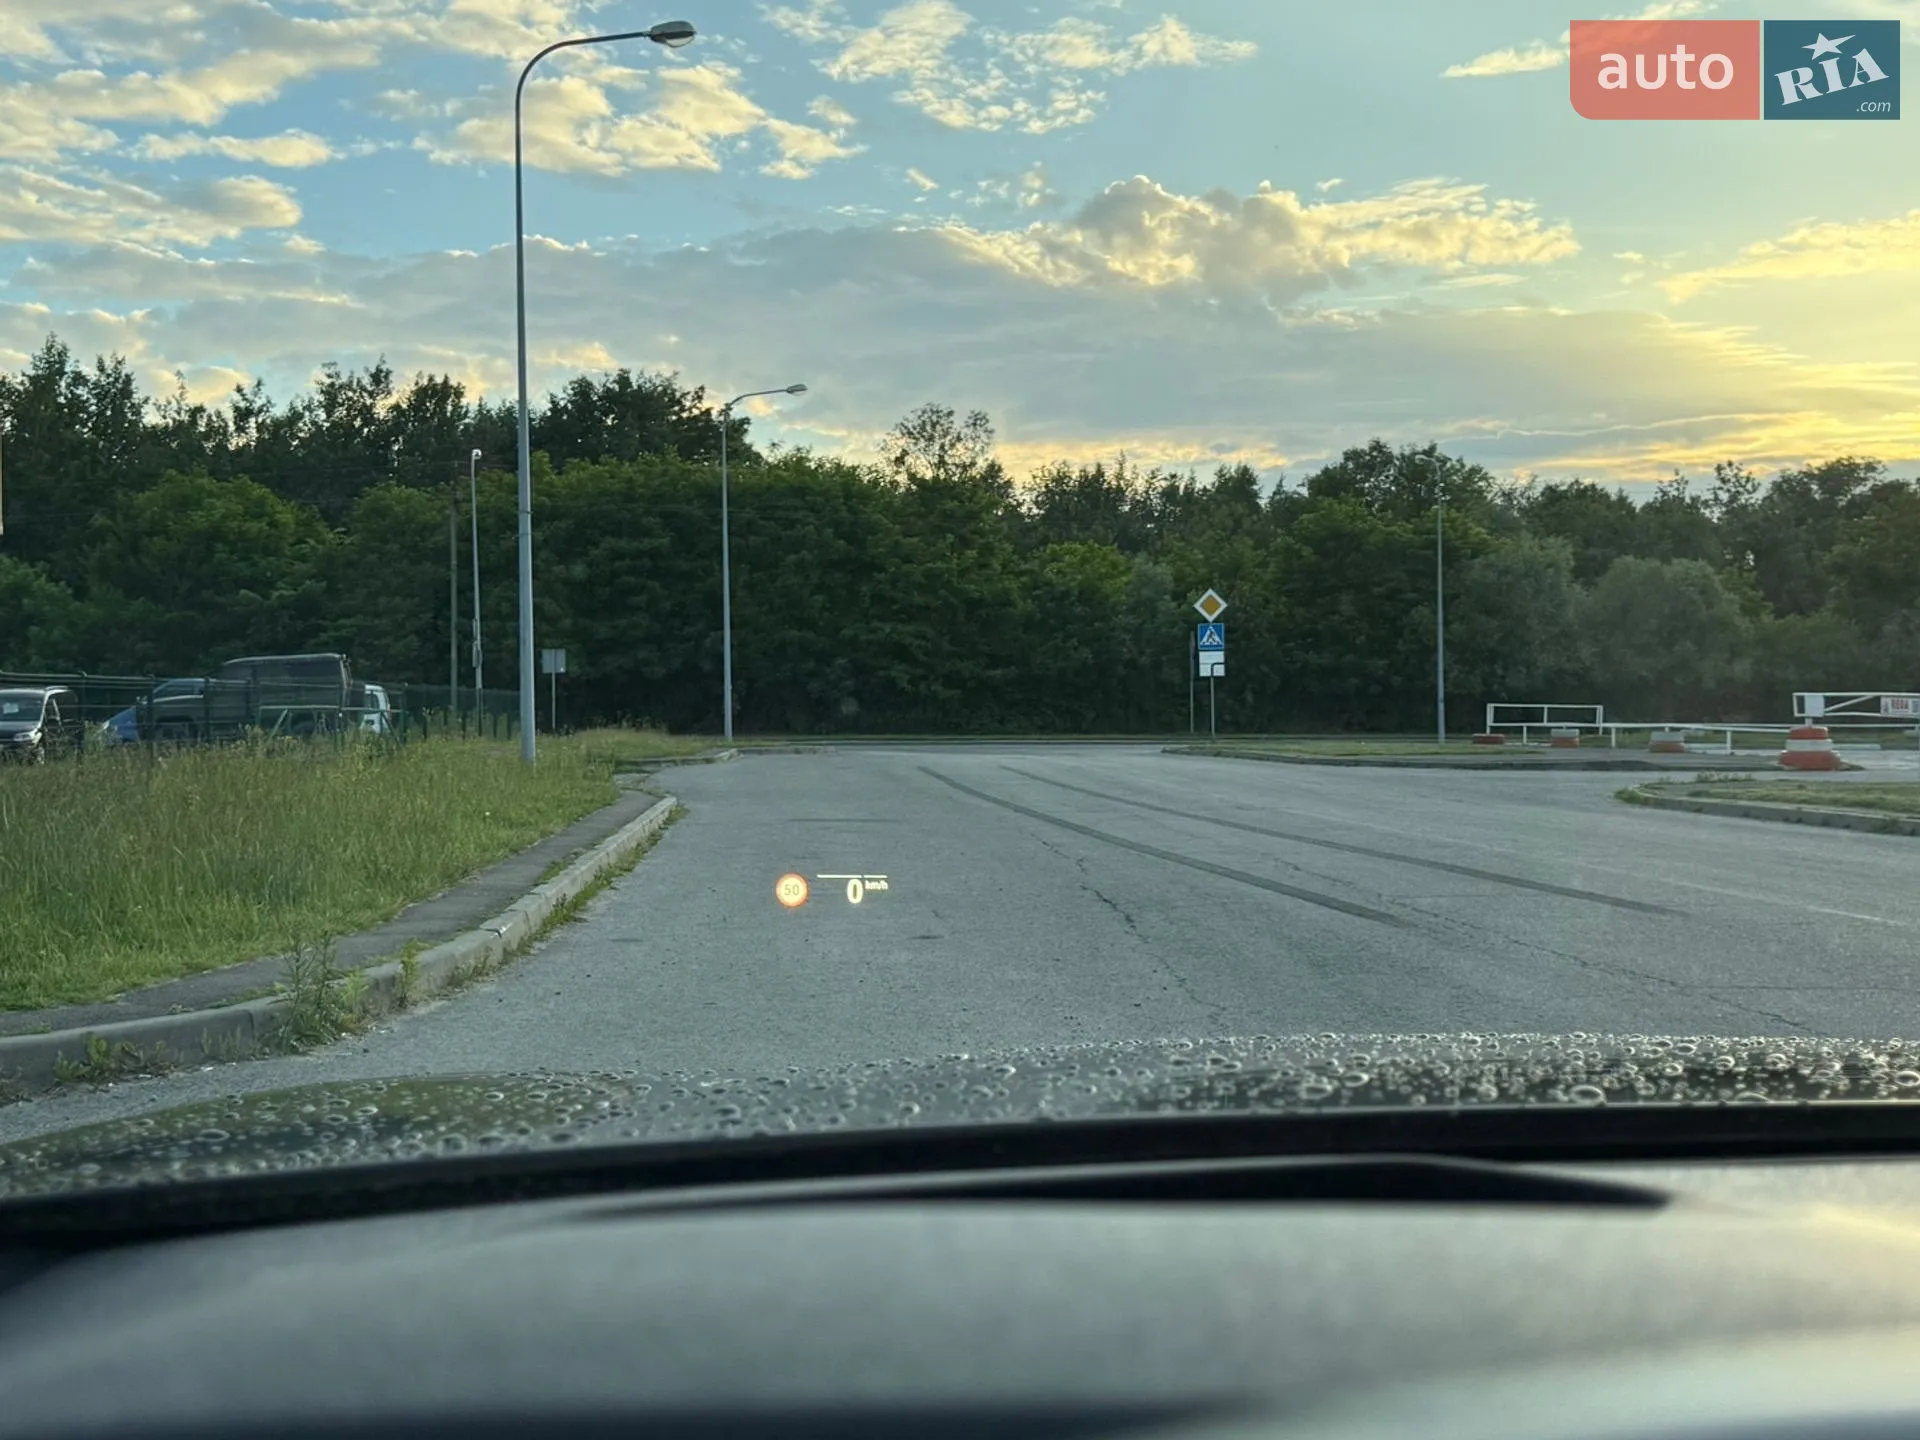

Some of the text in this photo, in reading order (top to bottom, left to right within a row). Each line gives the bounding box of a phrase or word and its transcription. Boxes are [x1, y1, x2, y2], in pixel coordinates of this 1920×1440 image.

[783, 883, 800, 896] 50
[847, 878, 888, 904] 0 km/h
